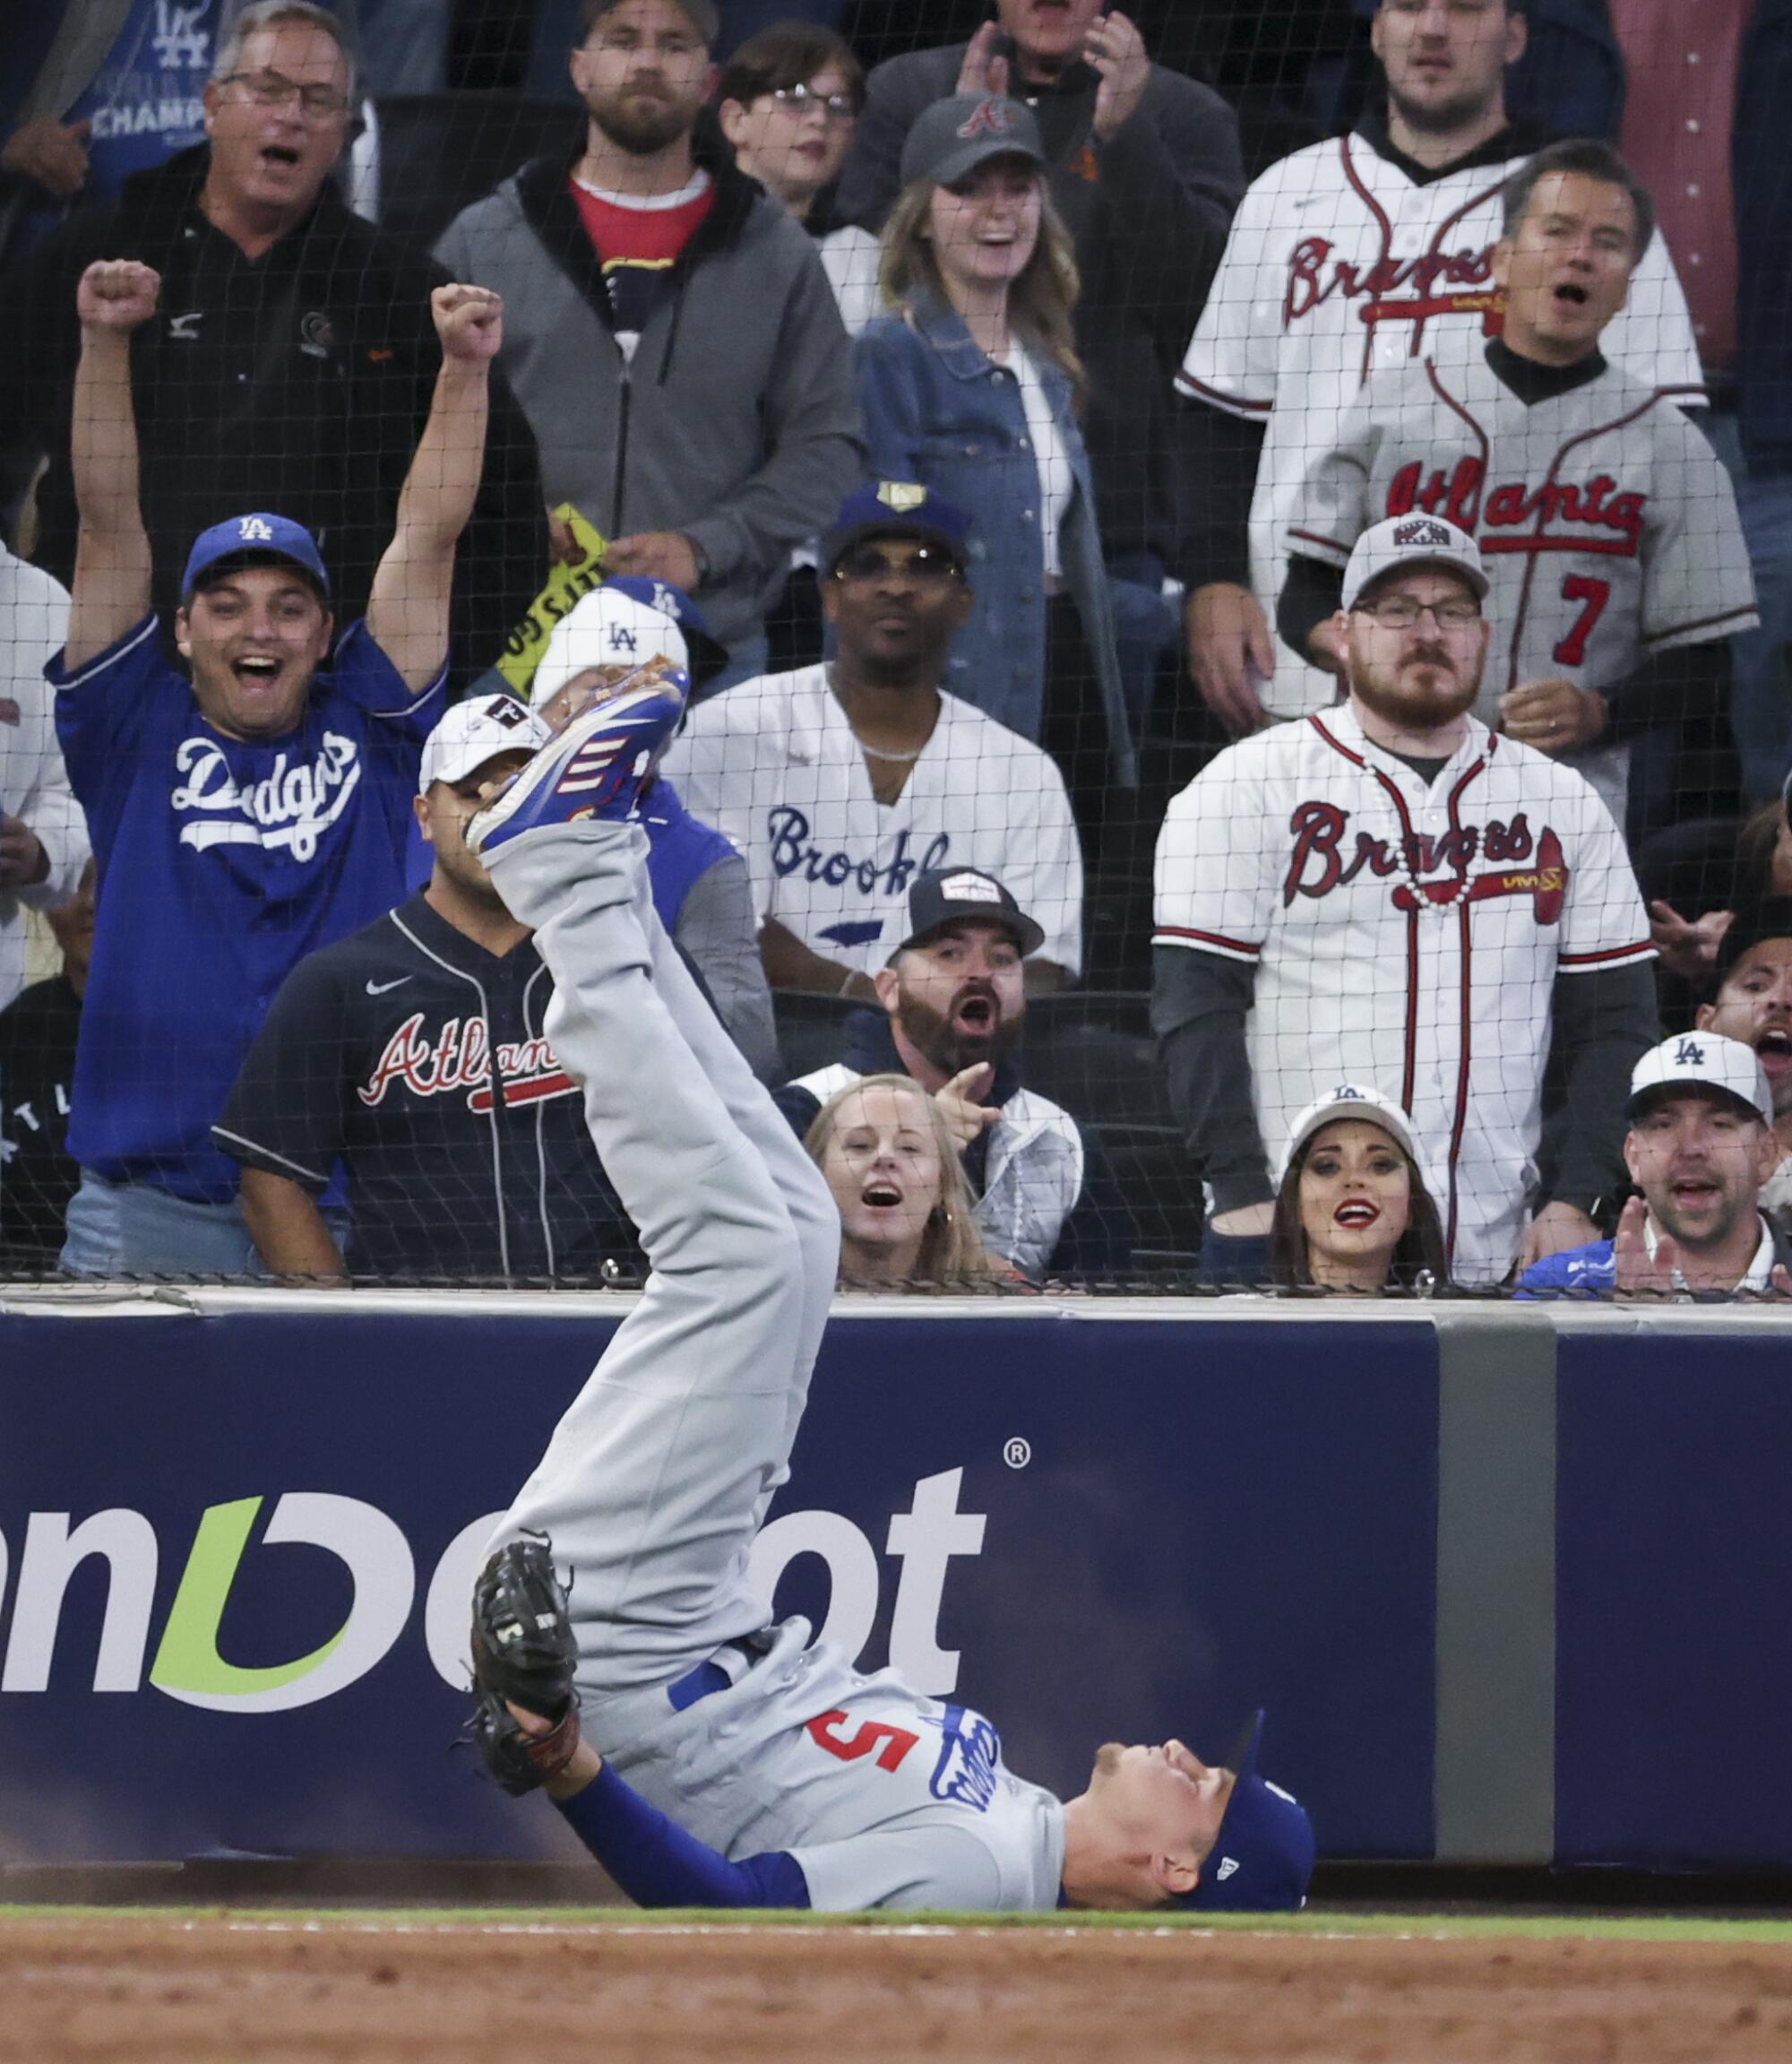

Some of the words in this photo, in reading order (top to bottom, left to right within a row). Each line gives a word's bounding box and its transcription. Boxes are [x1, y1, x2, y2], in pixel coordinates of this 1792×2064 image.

[1386, 454, 1647, 541] Atlanta
[238, 515, 272, 540] LA
[608, 621, 637, 652] LA
[1553, 572, 1610, 667] 7
[1284, 800, 1533, 908] Braves
[1675, 1037, 1704, 1066] LA
[1332, 1084, 1366, 1101] LA
[805, 1710, 919, 1773] 5
